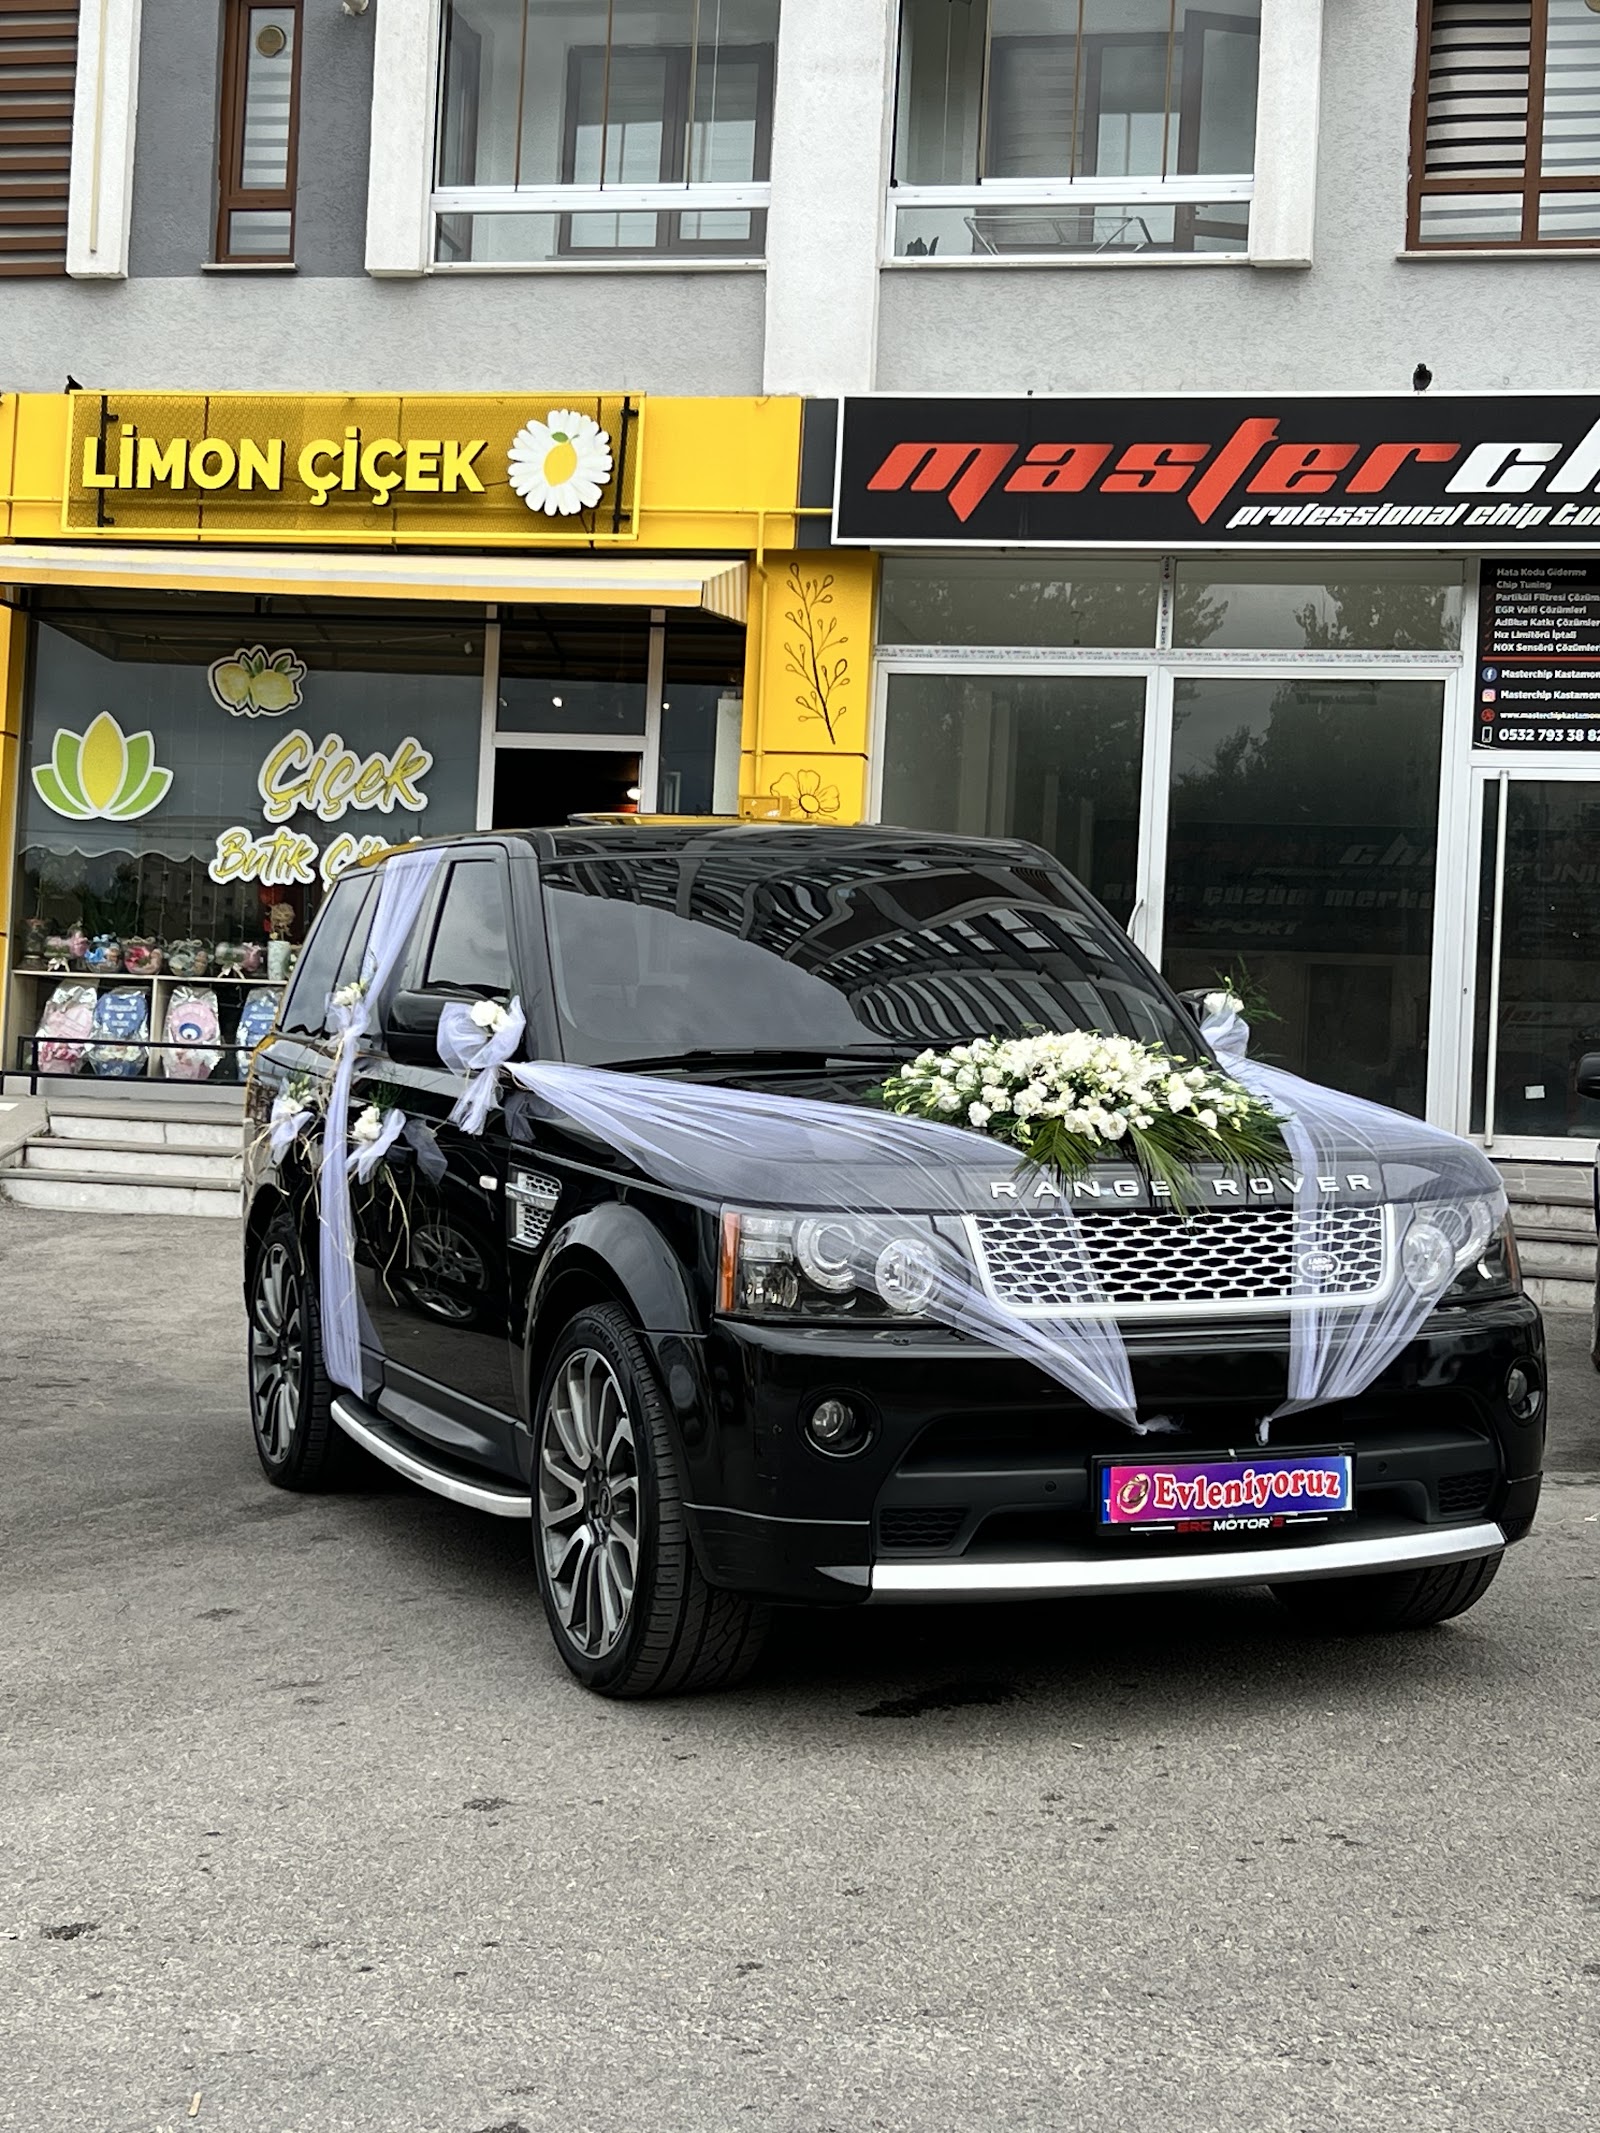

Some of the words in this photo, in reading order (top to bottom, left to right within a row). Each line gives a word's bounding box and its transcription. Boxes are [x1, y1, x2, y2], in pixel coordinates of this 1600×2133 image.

[82, 423, 285, 491] LİMON
[298, 425, 488, 507] ÇİÇEK
[1225, 503, 1468, 530] professional
[1463, 503, 1555, 529] chip
[1548, 503, 1600, 526] tu
[1496, 568, 1519, 577] Hata
[1520, 568, 1545, 577] Kodu
[1546, 568, 1587, 577] Giderme
[1496, 581, 1518, 590] Chip
[1520, 581, 1552, 591] Tuning
[1495, 593, 1532, 601] Partikül
[1533, 593, 1566, 601] Filtresi
[1495, 606, 1515, 614] EGR
[1516, 605, 1538, 614] Valfi
[1539, 605, 1587, 616] Çözümleri
[1494, 618, 1528, 627] AdBlue
[1493, 643, 1515, 652] NOX
[1501, 669, 1553, 680] Masterchip
[1500, 690, 1552, 701] Masterchip
[1498, 728, 1535, 741] 0532
[1537, 728, 1564, 742] 793
[1566, 729, 1584, 742] 38
[261, 731, 430, 820] Çiçek
[990, 1178, 1171, 1200] RANGE
[1212, 1173, 1373, 1196] ROVER
[1153, 1468, 1341, 1511] Evleniyoruz
